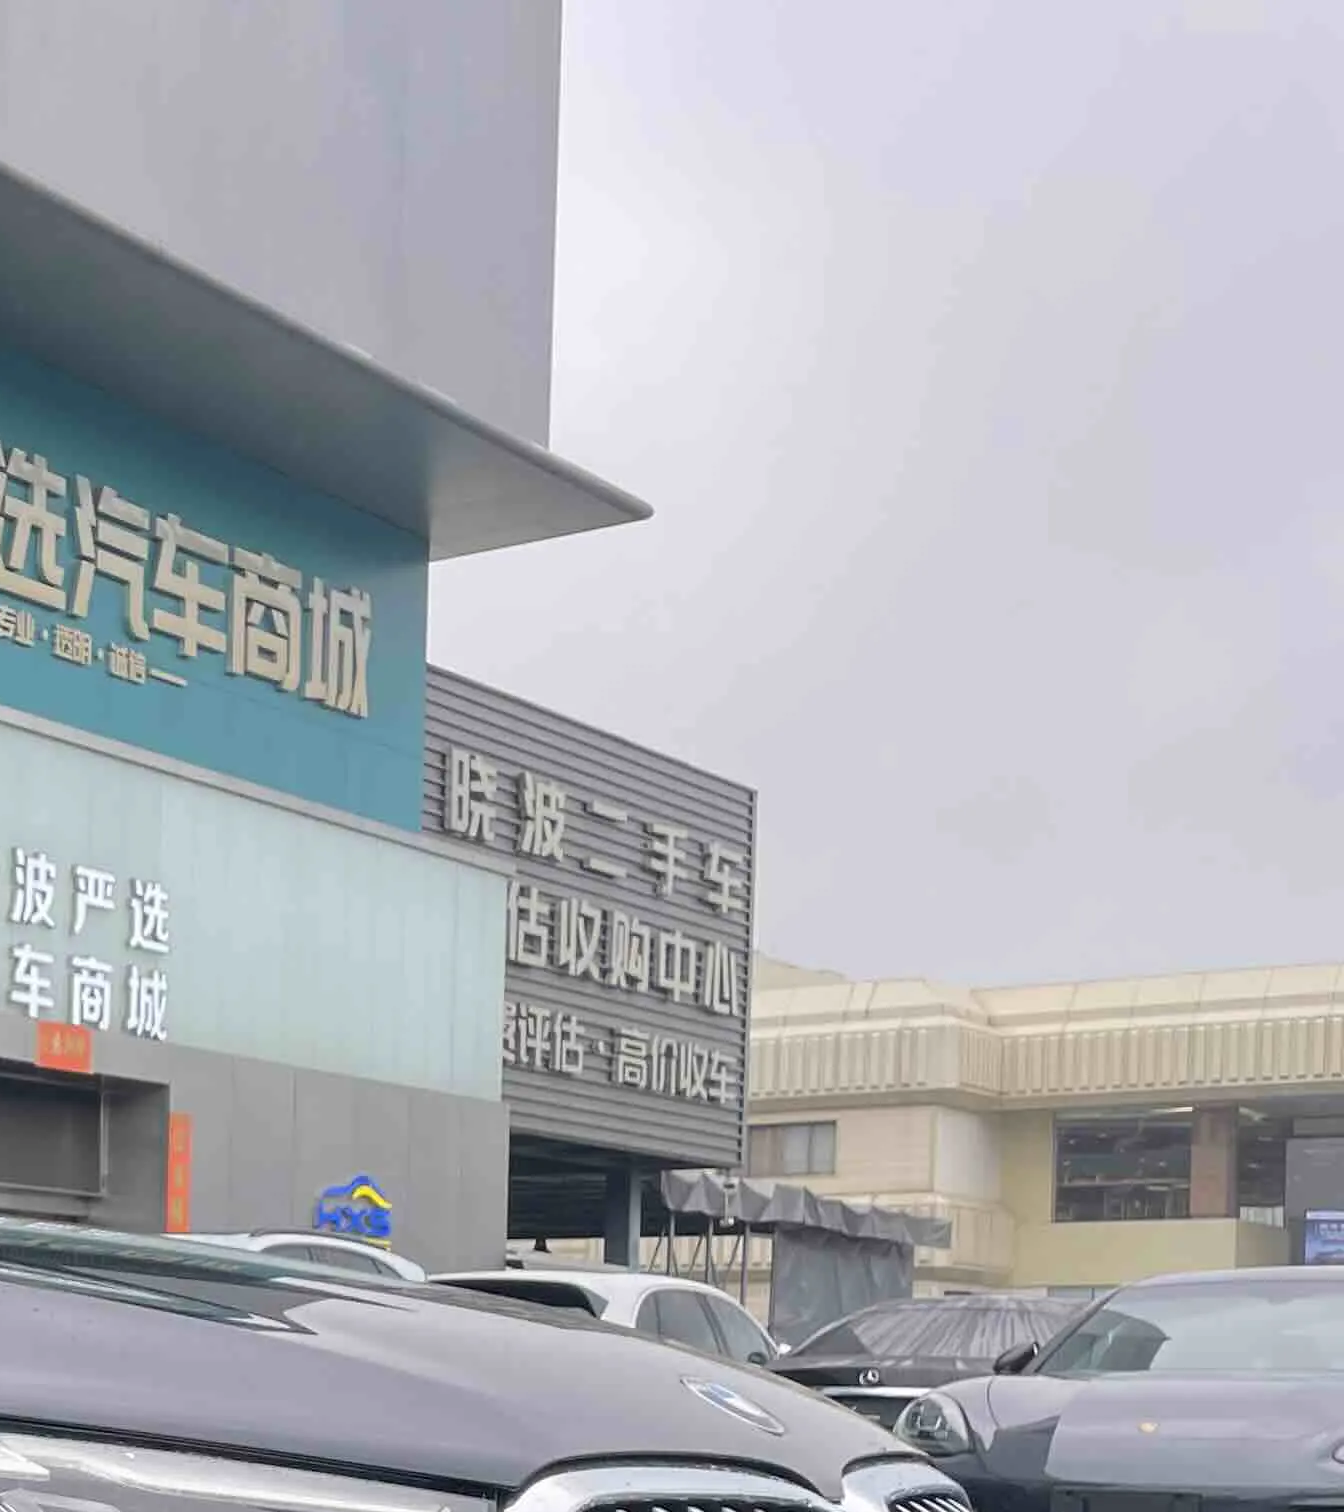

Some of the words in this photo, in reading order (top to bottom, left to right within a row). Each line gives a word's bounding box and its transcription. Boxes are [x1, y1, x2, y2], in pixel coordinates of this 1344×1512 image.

[447, 746, 745, 913] 晓波二手车
